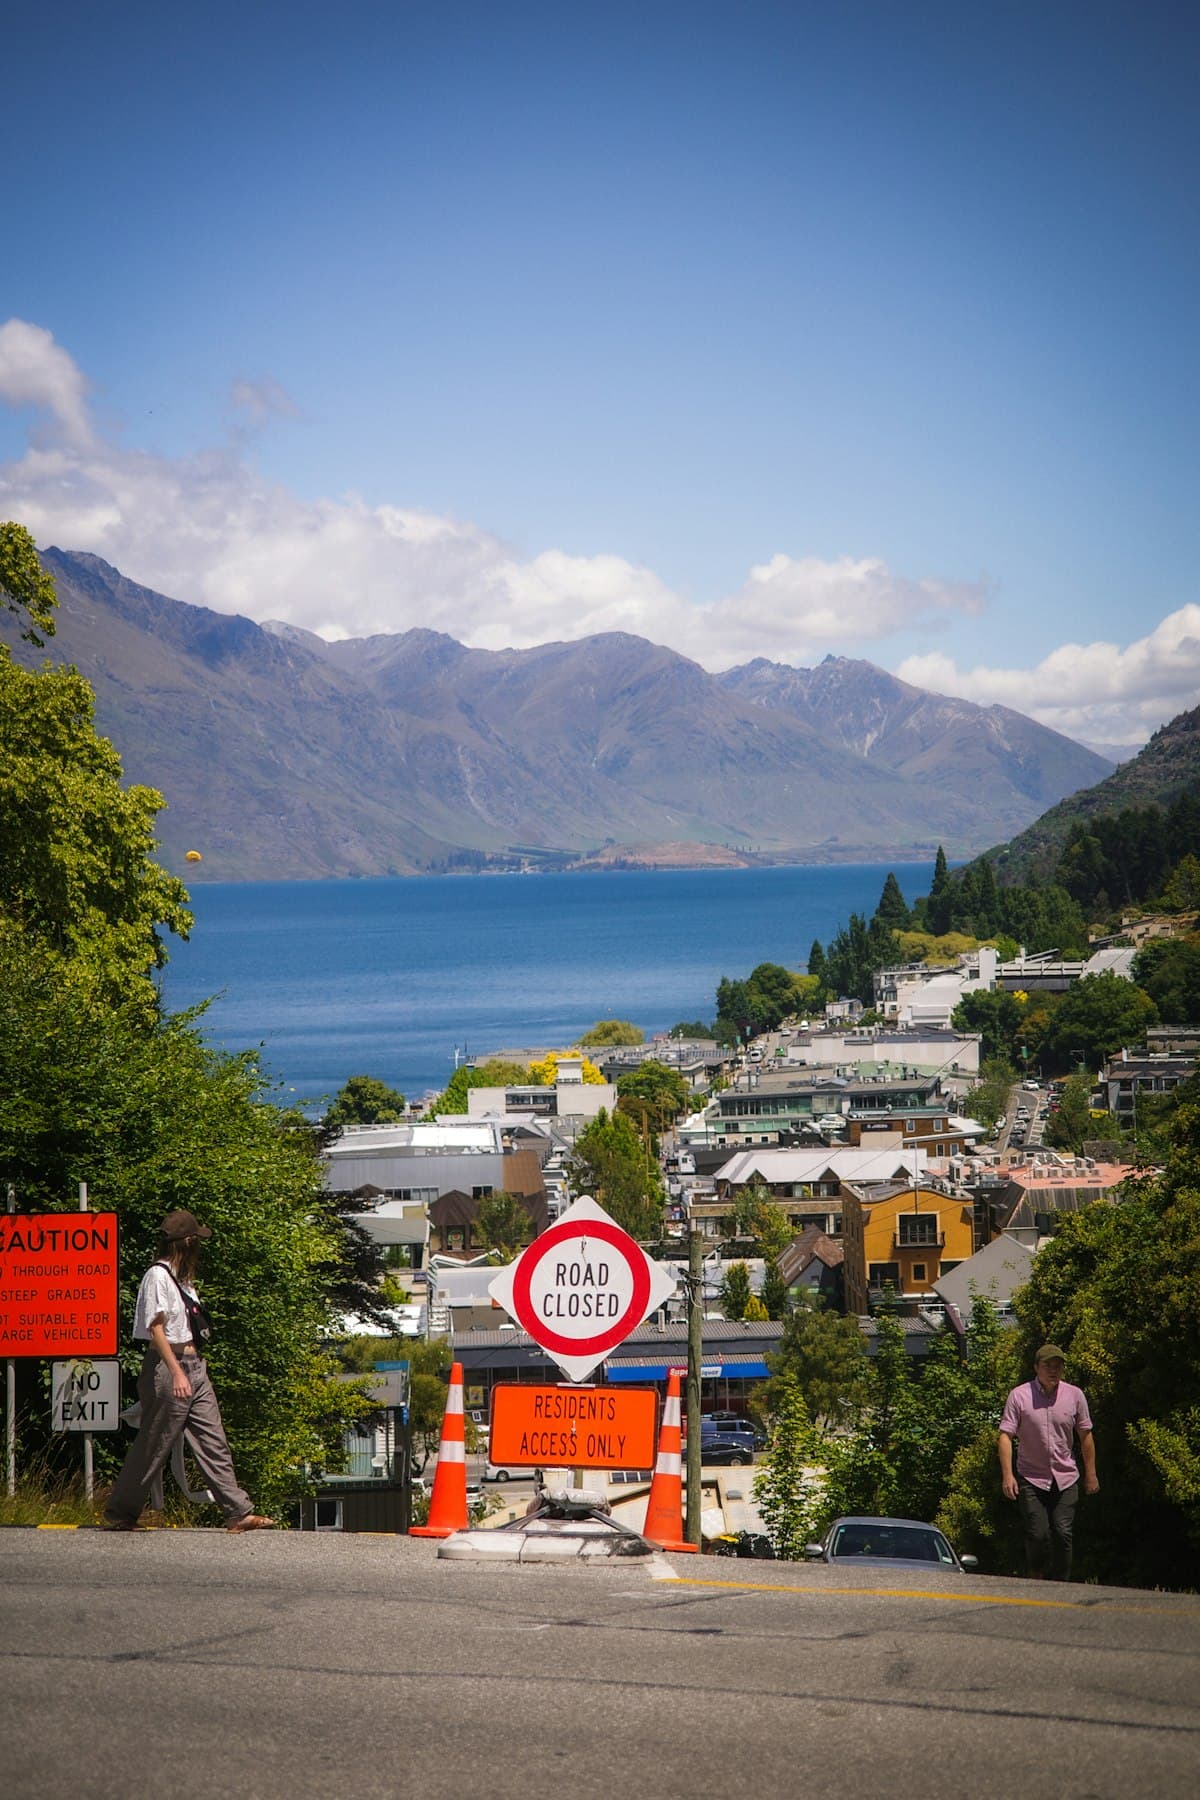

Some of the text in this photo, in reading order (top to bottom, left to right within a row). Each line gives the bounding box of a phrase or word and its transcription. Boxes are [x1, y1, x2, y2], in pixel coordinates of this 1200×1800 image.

[0, 1229, 108, 1252] AUTION
[13, 1265, 69, 1277] THROUGH
[77, 1264, 110, 1276] ROAD
[555, 1262, 609, 1287] ROAD
[1, 1289, 96, 1301] STEEP GRADES
[543, 1293, 619, 1317] CLOSED
[19, 1313, 77, 1326] SUITABLE
[86, 1312, 110, 1324] FOR
[0, 1328, 102, 1341] ARGE VEHICLES
[71, 1371, 100, 1391] NO
[62, 1401, 109, 1421] EXIT
[534, 1395, 616, 1421] RESIDENTS
[520, 1432, 626, 1458] ACCESS ONLY
